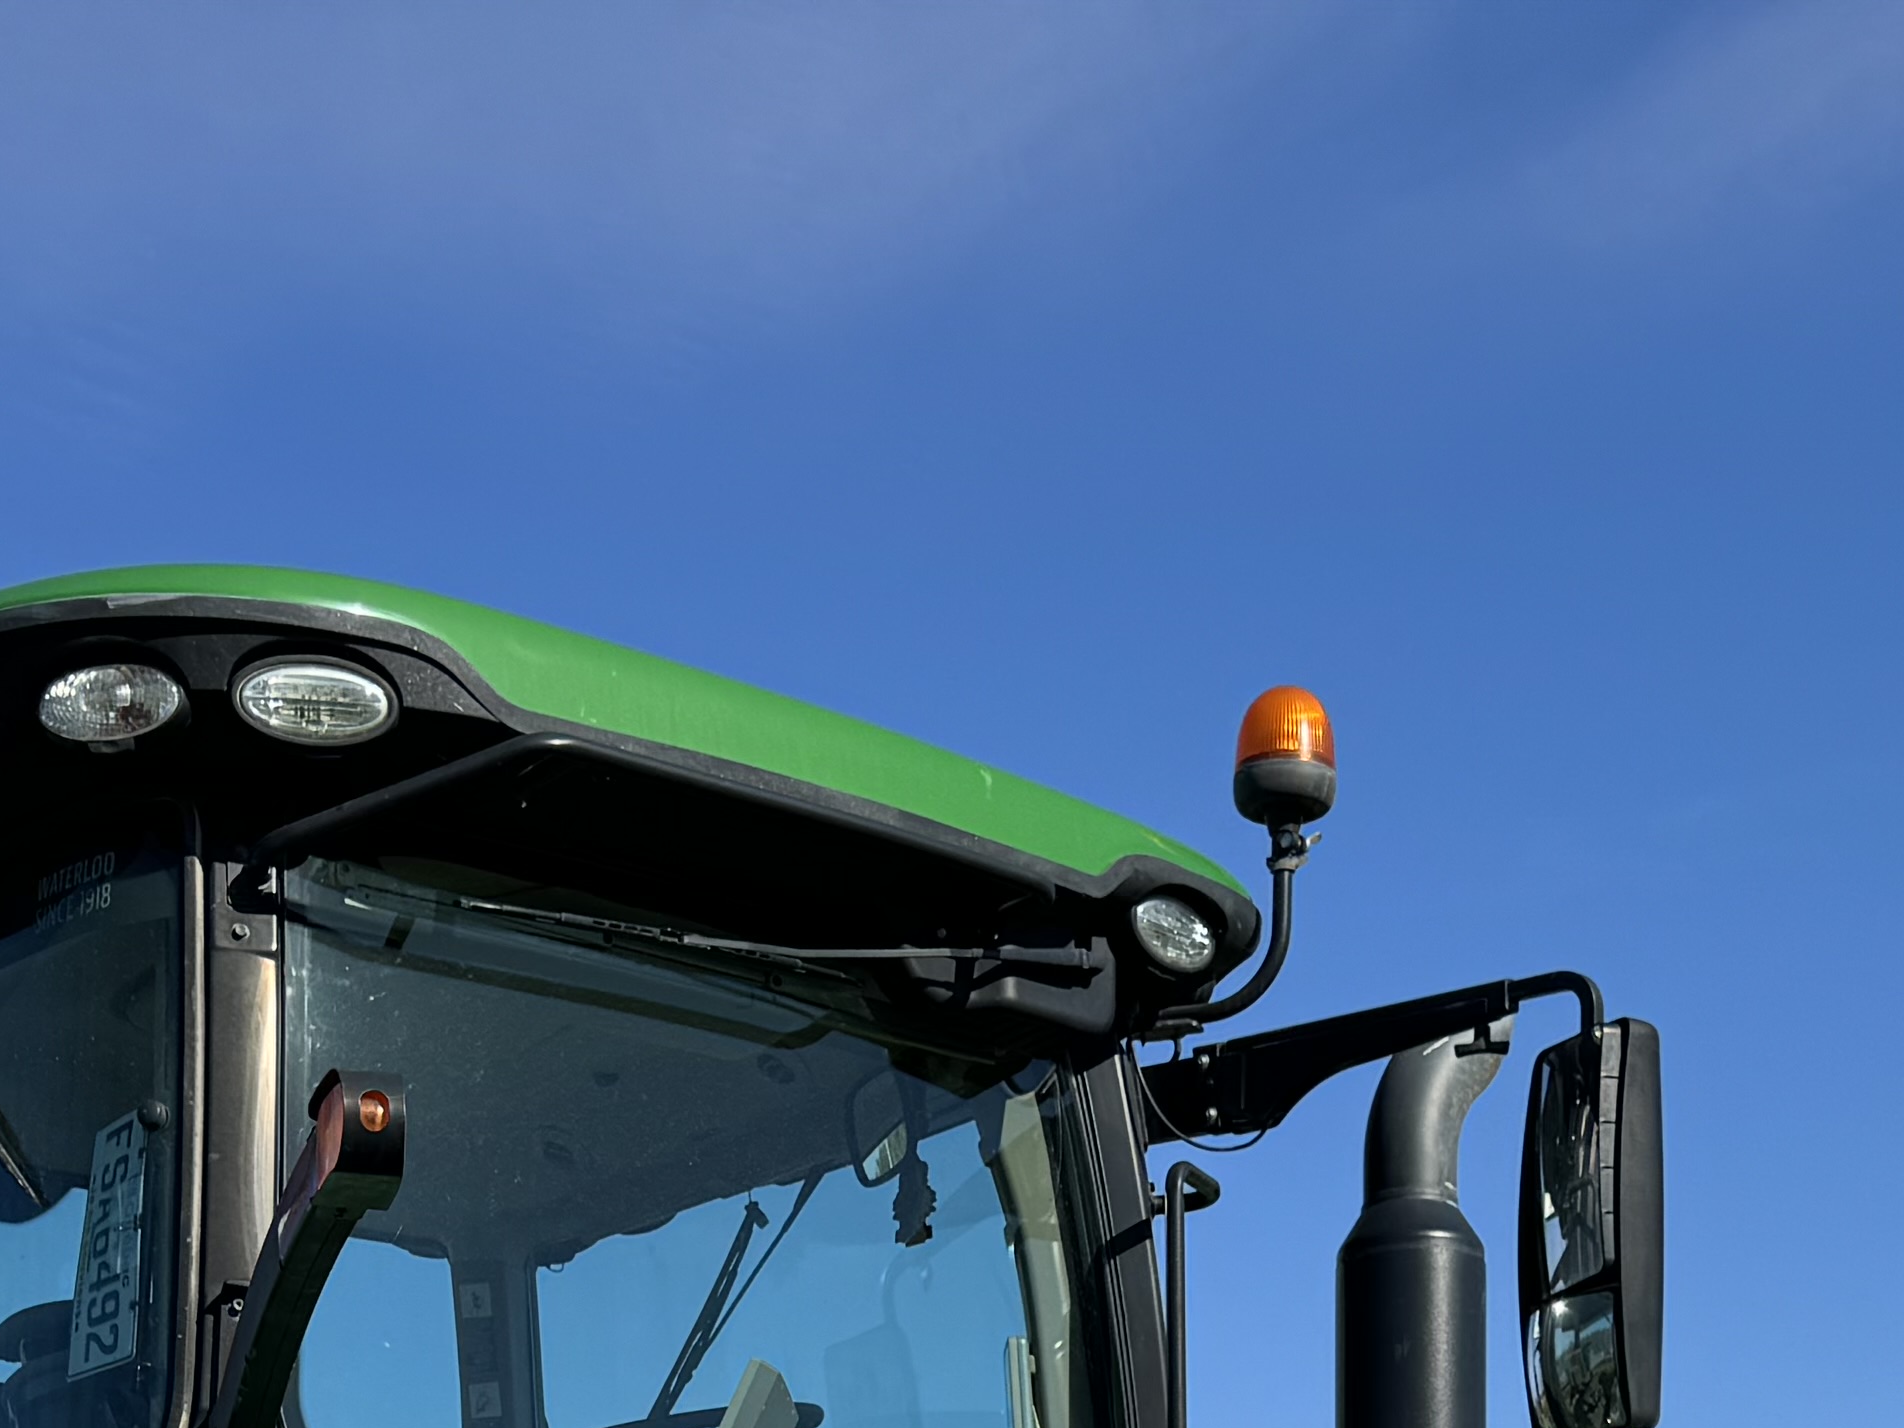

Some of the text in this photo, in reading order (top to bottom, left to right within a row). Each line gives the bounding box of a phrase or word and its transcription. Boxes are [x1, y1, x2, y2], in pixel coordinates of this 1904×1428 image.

[38, 851, 116, 901] WATERLOO
[34, 882, 112, 935] SINCE 1918
